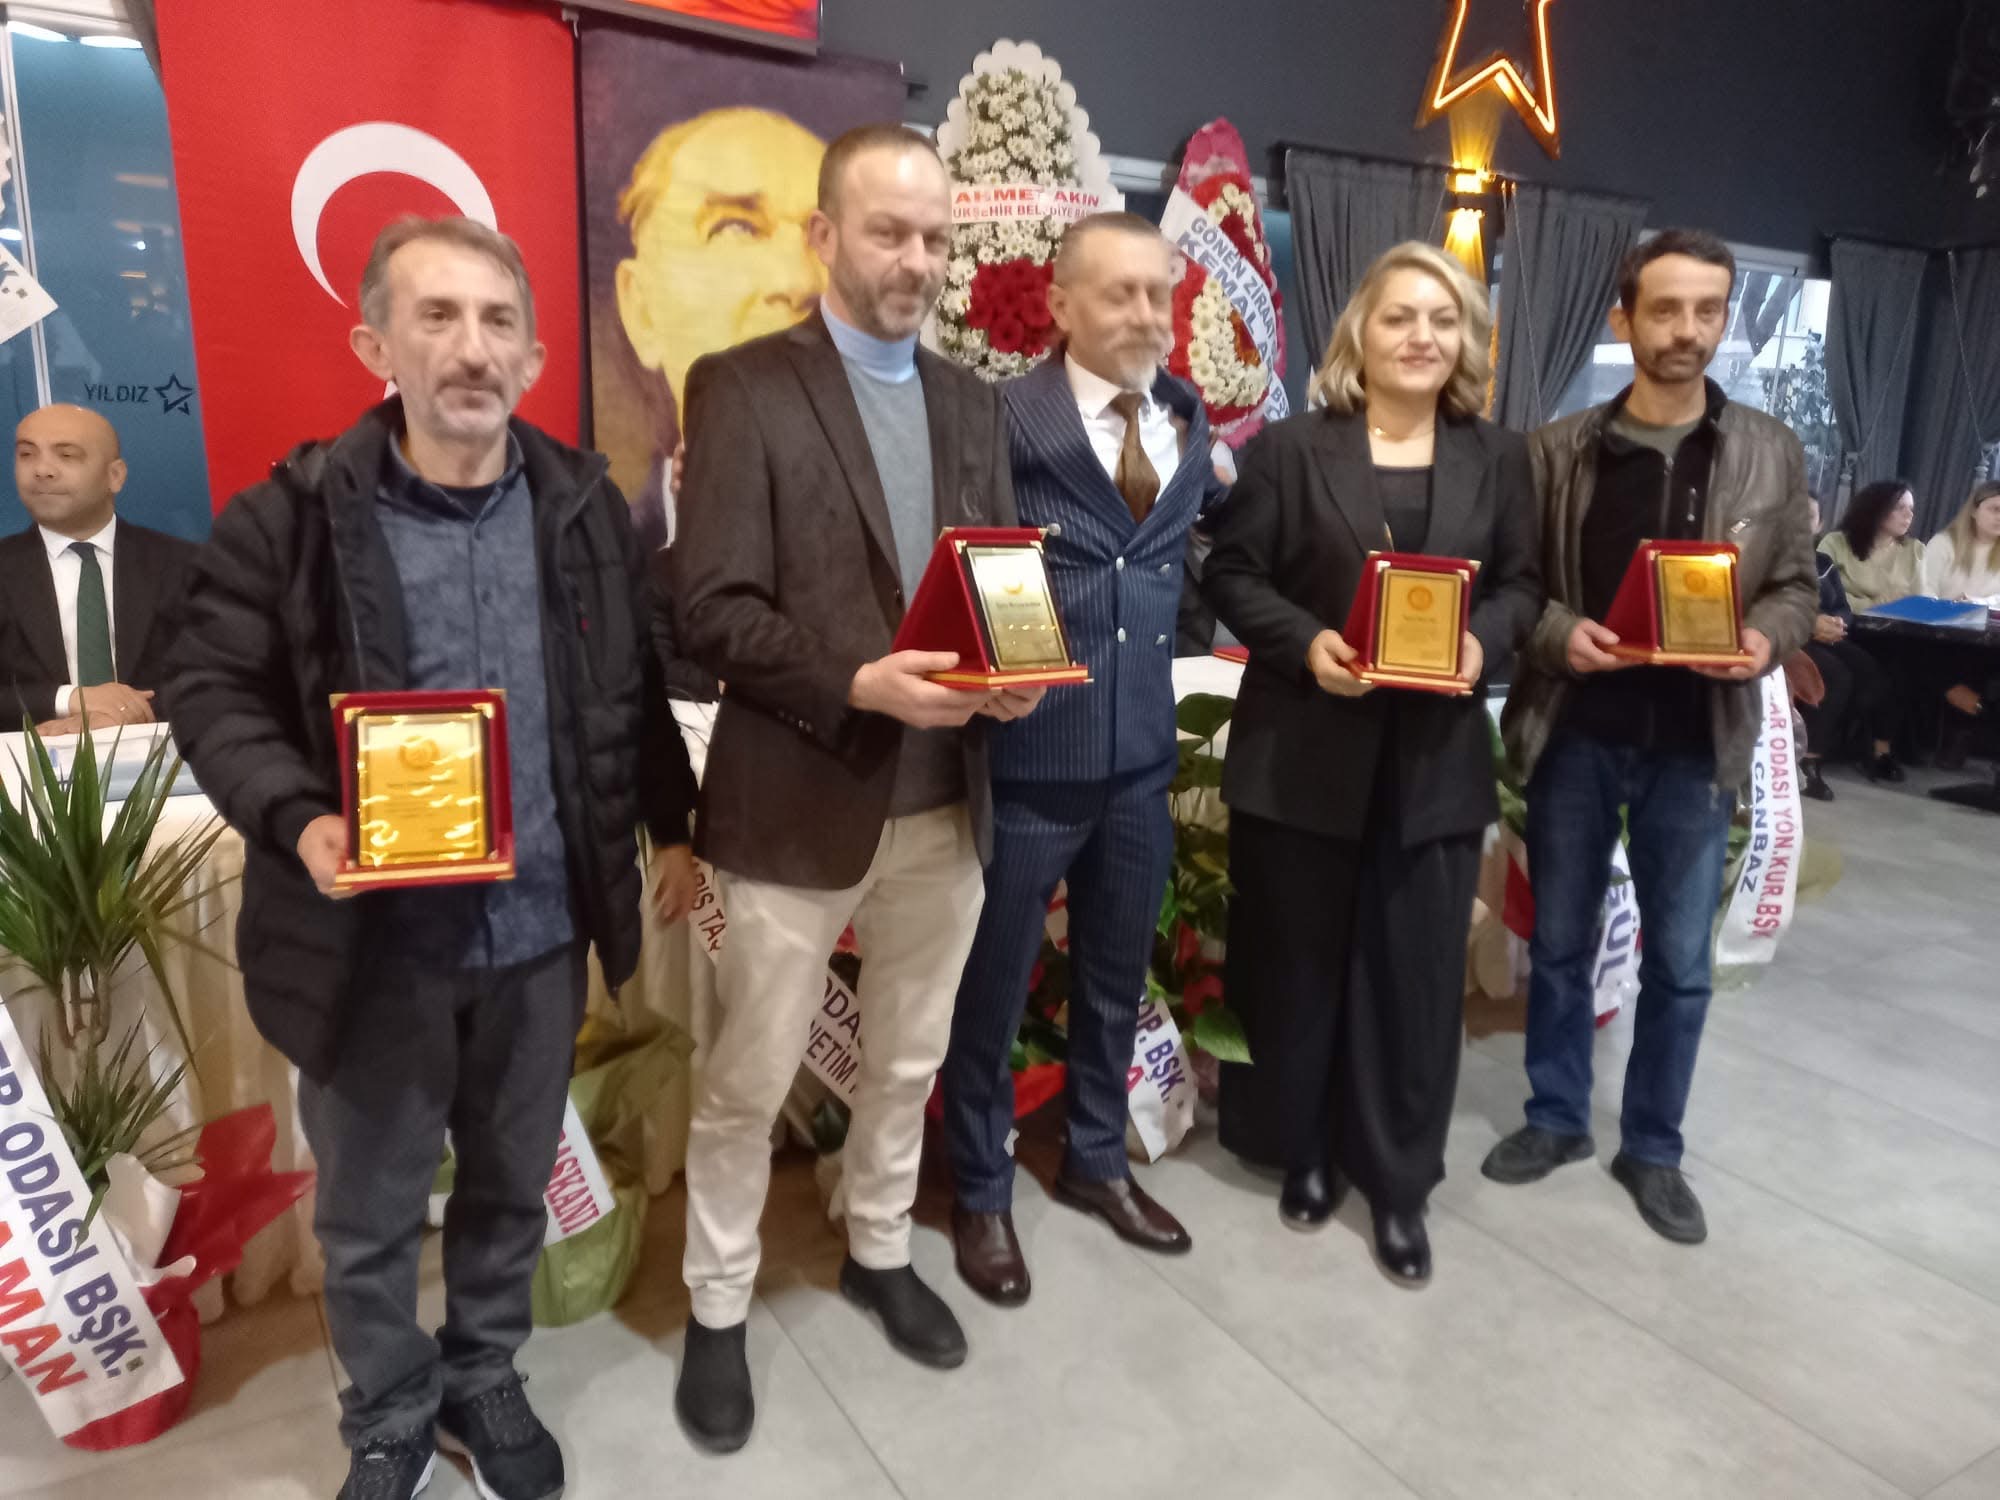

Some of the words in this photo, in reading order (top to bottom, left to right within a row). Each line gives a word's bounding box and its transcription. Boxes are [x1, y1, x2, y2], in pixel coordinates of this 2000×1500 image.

[1017, 204, 1072, 217] BELDİYE
[1054, 191, 1099, 207] AKIN
[1177, 231, 1254, 334] KEMAL
[1191, 217, 1246, 279] GÖNEN
[1244, 275, 1275, 339] ZİRAAT
[84, 383, 149, 403] YILDIZ
[1770, 738, 1790, 800] ODASI
[1740, 762, 1769, 893] CANBAZ
[699, 908, 727, 952] TA
[0, 1121, 99, 1276] ODASI
